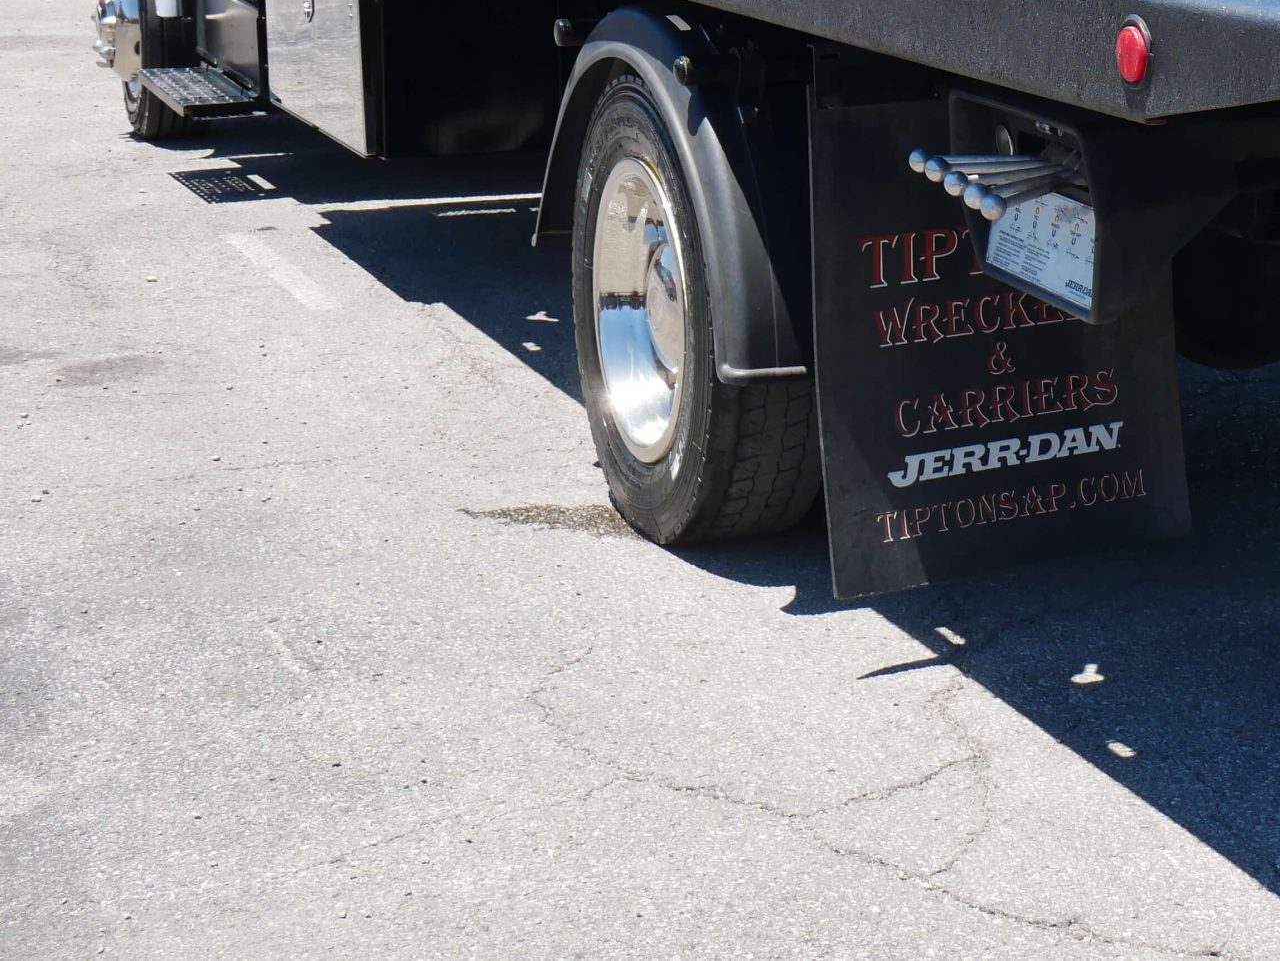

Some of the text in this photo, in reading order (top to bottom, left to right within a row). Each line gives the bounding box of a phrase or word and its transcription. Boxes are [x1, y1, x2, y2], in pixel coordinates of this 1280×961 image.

[873, 292, 1081, 348] WRECKE
[986, 340, 1017, 376] &
[893, 367, 1120, 439] CARRIERS
[887, 420, 1123, 488] JERR-DAN
[874, 468, 1148, 544] TIPTONSAP.COM
